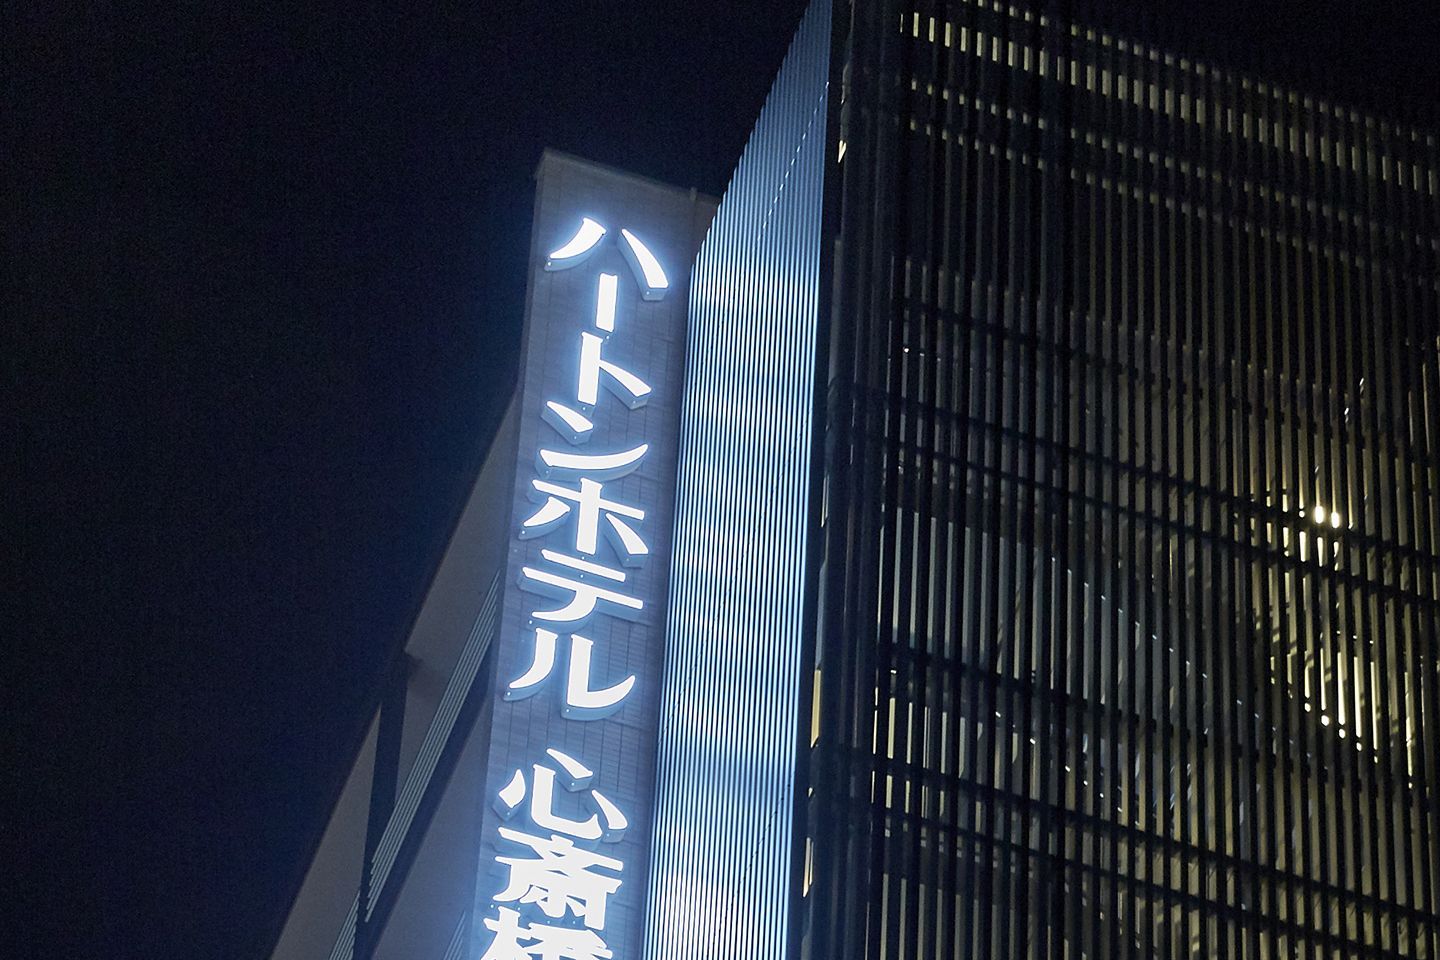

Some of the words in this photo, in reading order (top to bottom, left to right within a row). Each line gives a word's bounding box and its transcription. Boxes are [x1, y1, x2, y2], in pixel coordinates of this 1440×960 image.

[509, 216, 670, 709] ハートンホテル
